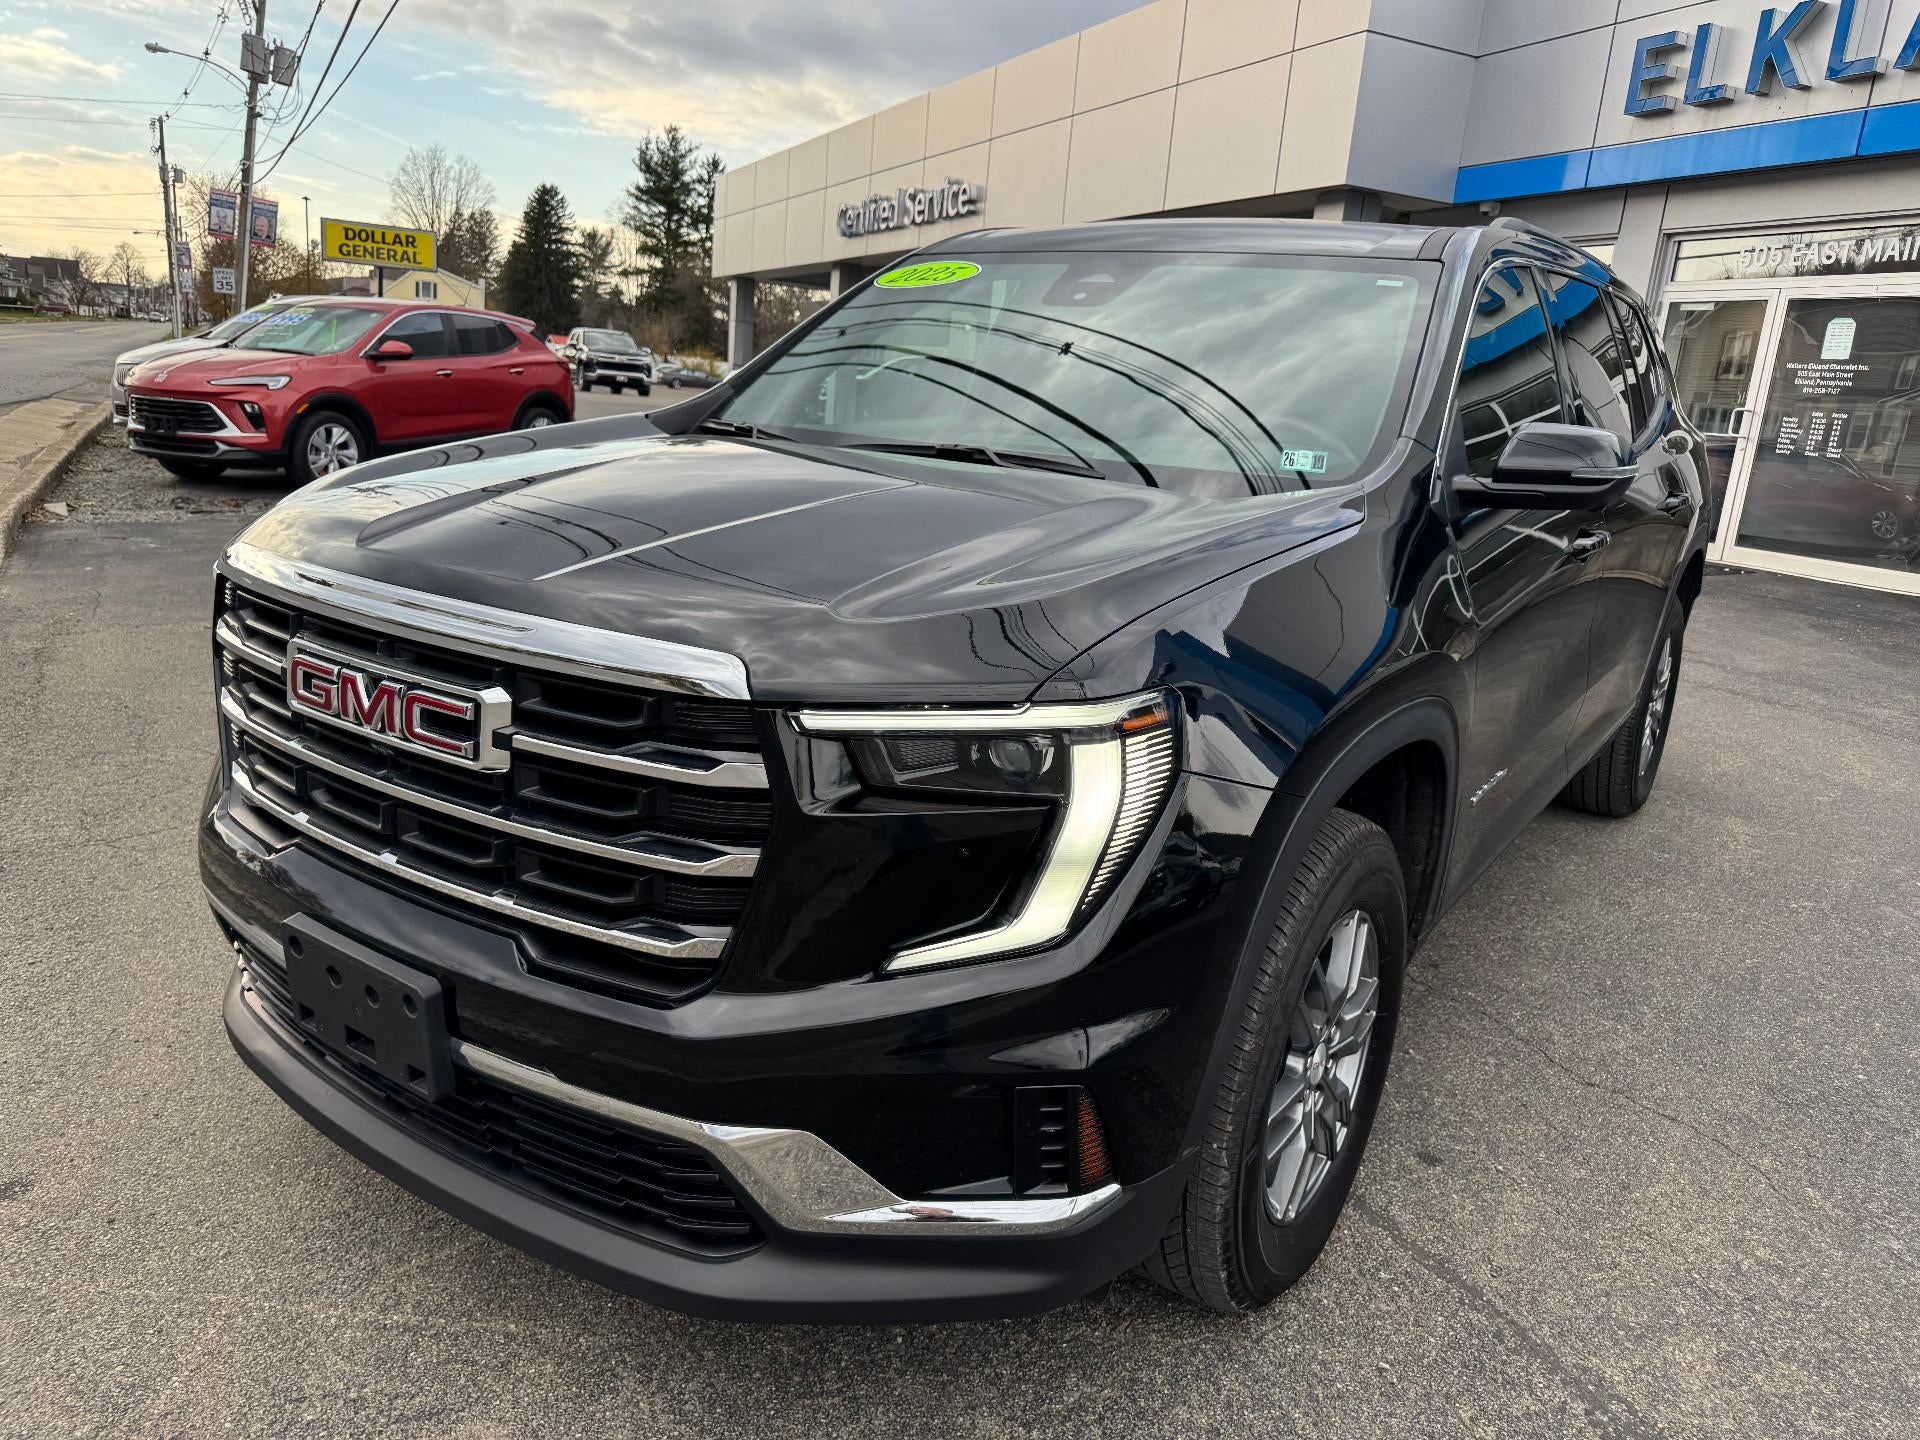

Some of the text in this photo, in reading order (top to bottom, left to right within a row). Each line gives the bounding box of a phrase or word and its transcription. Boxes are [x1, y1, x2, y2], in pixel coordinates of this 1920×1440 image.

[838, 177, 980, 238] Certified Service
[343, 227, 417, 248] DOLLAR
[338, 243, 422, 265] GENERAL
[1739, 246, 1784, 268] 505
[1790, 239, 1857, 267] EAST
[886, 266, 970, 284] 2025
[216, 280, 233, 291] 35
[1830, 363, 1857, 371] Chevrolet
[1836, 371, 1854, 379] Street
[1815, 378, 1853, 387] Pennsylvania
[1283, 451, 1296, 467] 26
[291, 654, 475, 759] GMC
